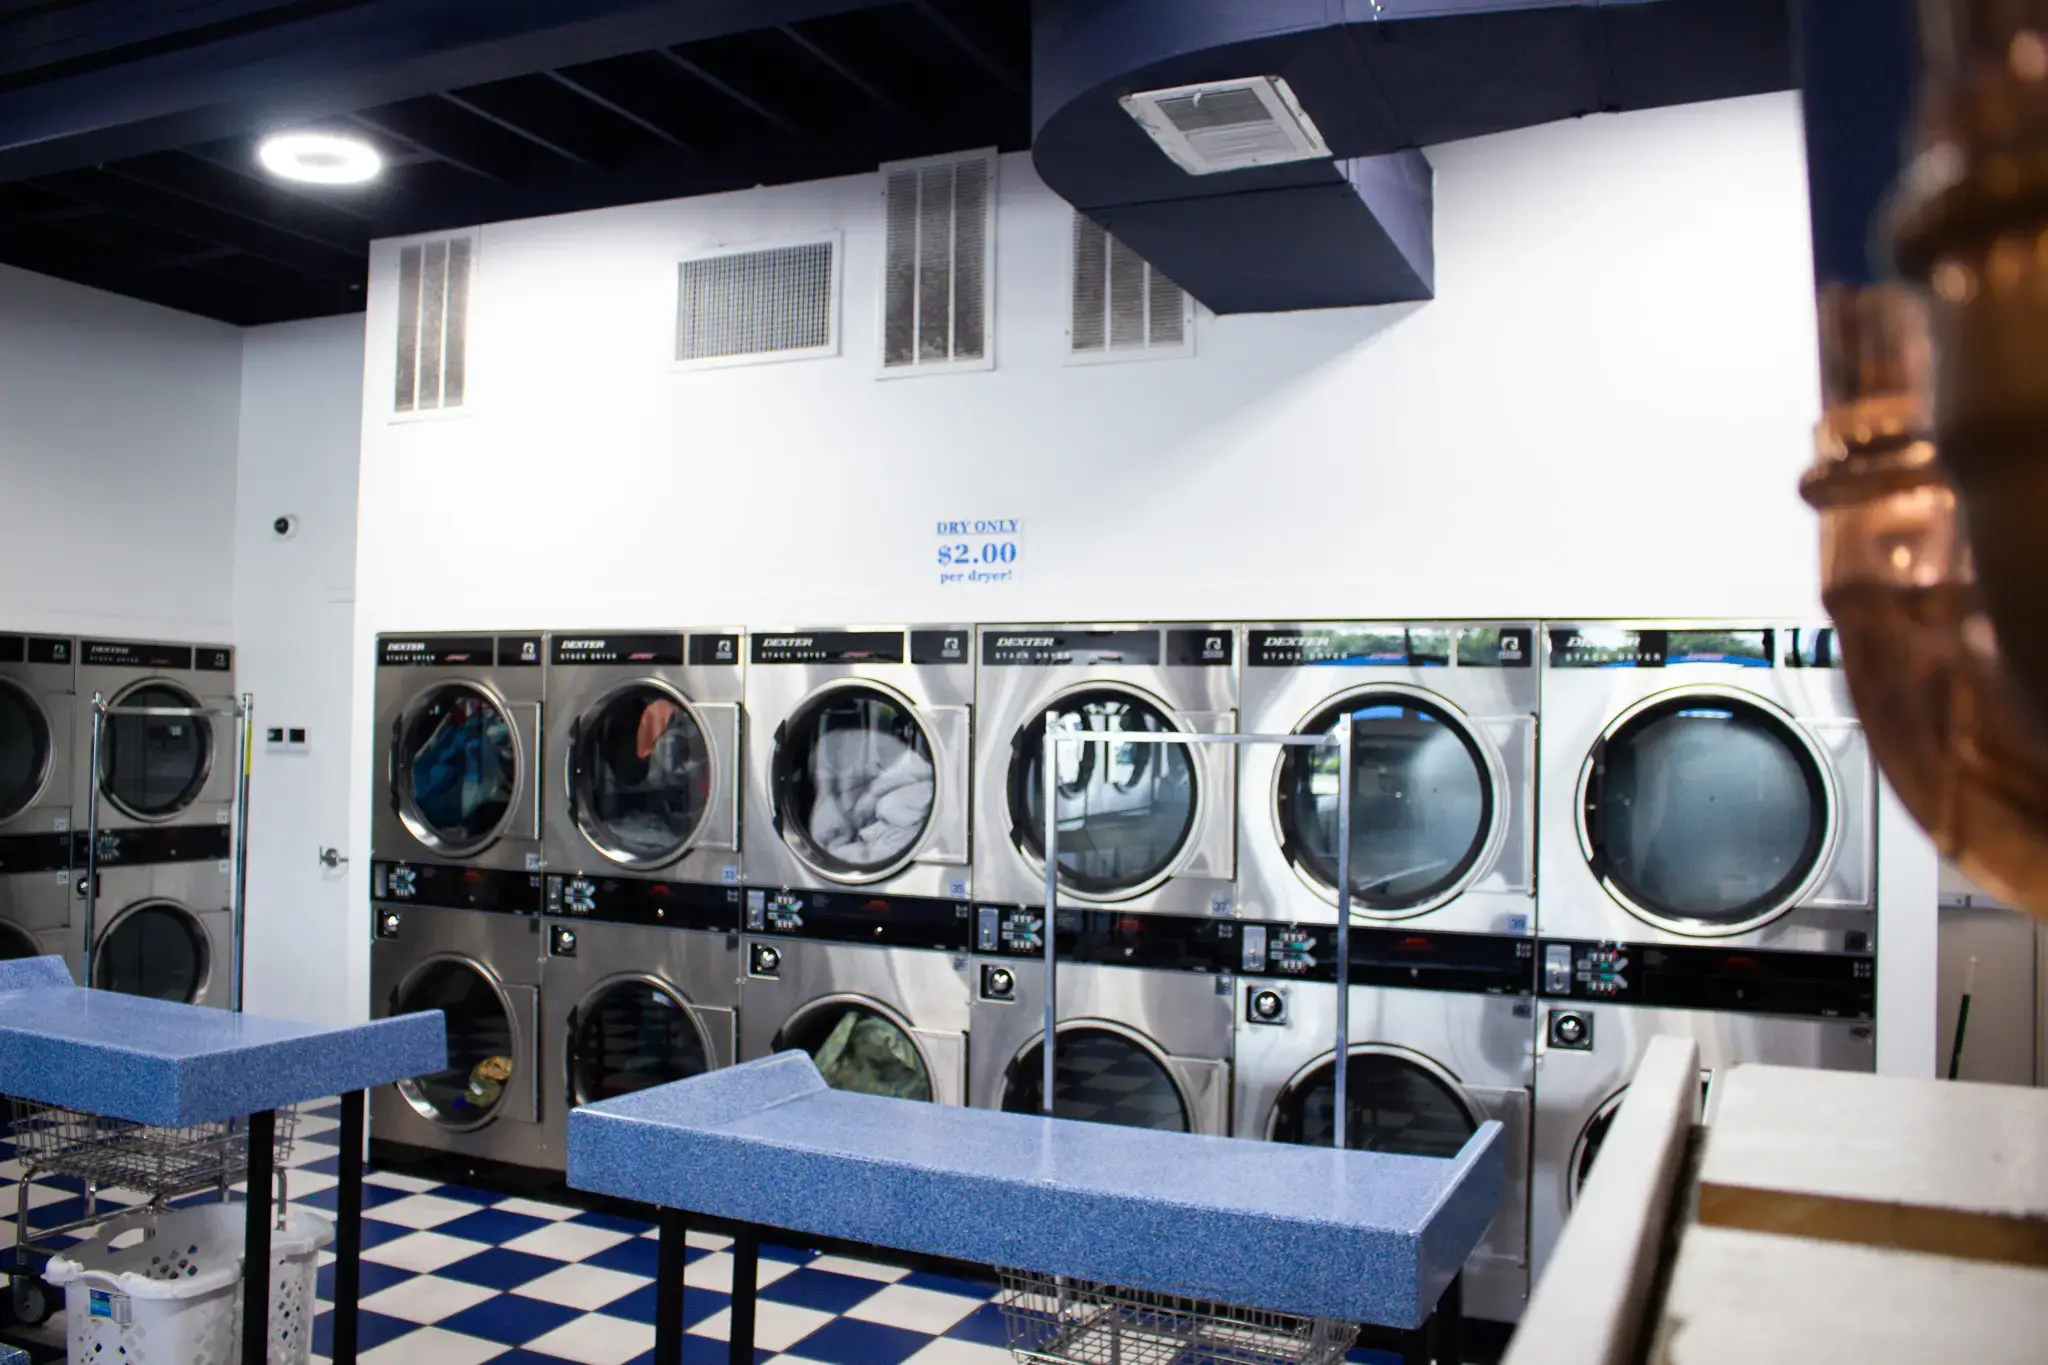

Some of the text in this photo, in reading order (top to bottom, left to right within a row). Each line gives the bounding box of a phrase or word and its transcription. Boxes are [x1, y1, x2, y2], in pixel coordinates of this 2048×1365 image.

[937, 519, 1018, 535] DRY ONLY
[937, 542, 1017, 567] $2.00
[940, 569, 1013, 584] per dryer!
[561, 640, 606, 650] DEXTER
[762, 637, 814, 648] DEXTER
[996, 636, 1055, 647] DEXTER
[1263, 636, 1330, 647] DEXTER
